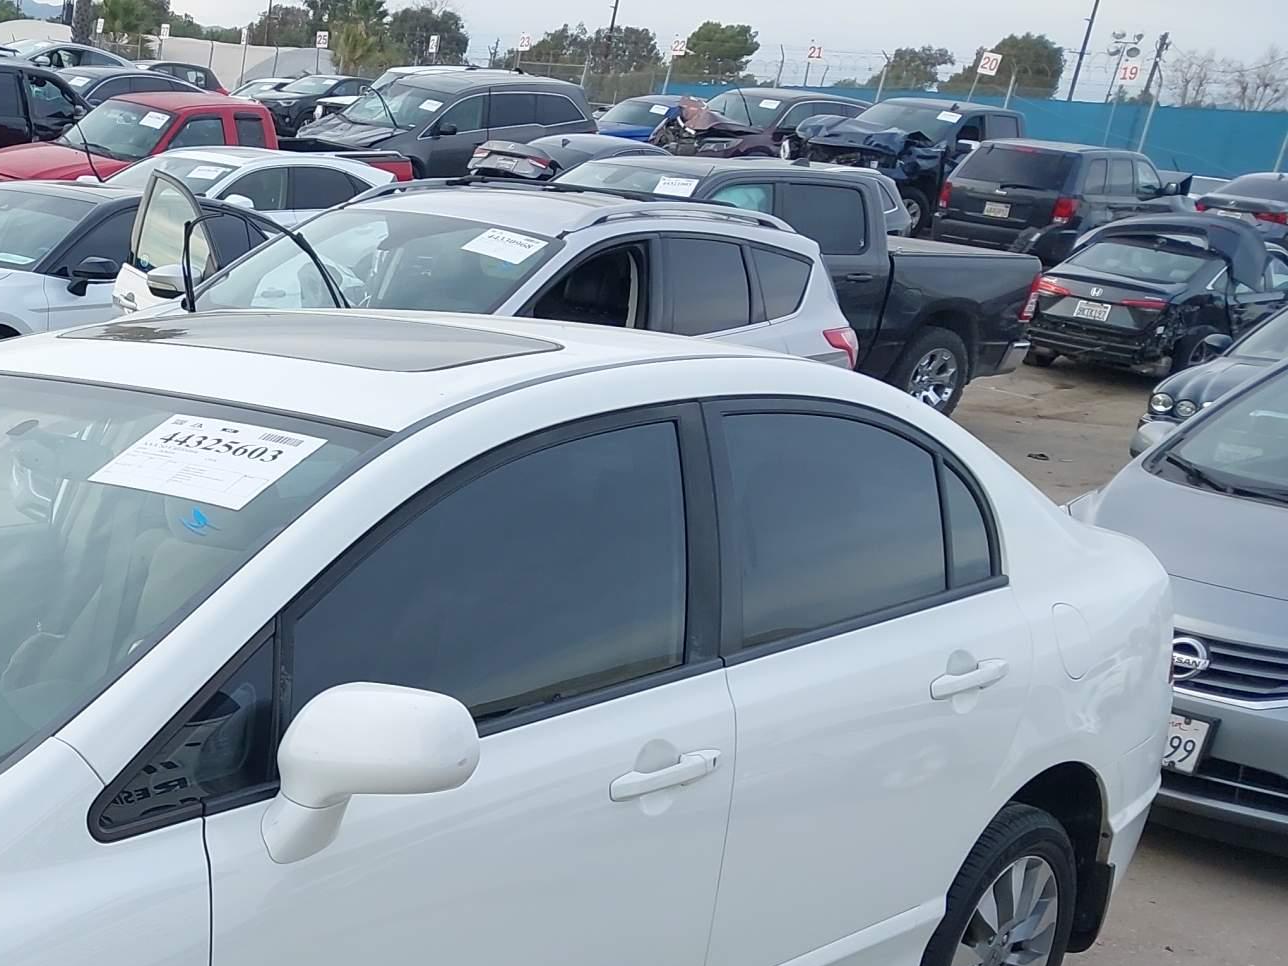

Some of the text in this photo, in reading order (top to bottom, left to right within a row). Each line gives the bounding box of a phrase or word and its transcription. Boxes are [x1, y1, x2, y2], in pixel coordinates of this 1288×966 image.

[317, 34, 328, 45] 25
[520, 36, 531, 47] 23
[673, 40, 686, 50] 22
[808, 46, 822, 58] 21
[980, 56, 999, 71] 20
[1120, 66, 1138, 80] 19
[159, 431, 284, 462] 44325603
